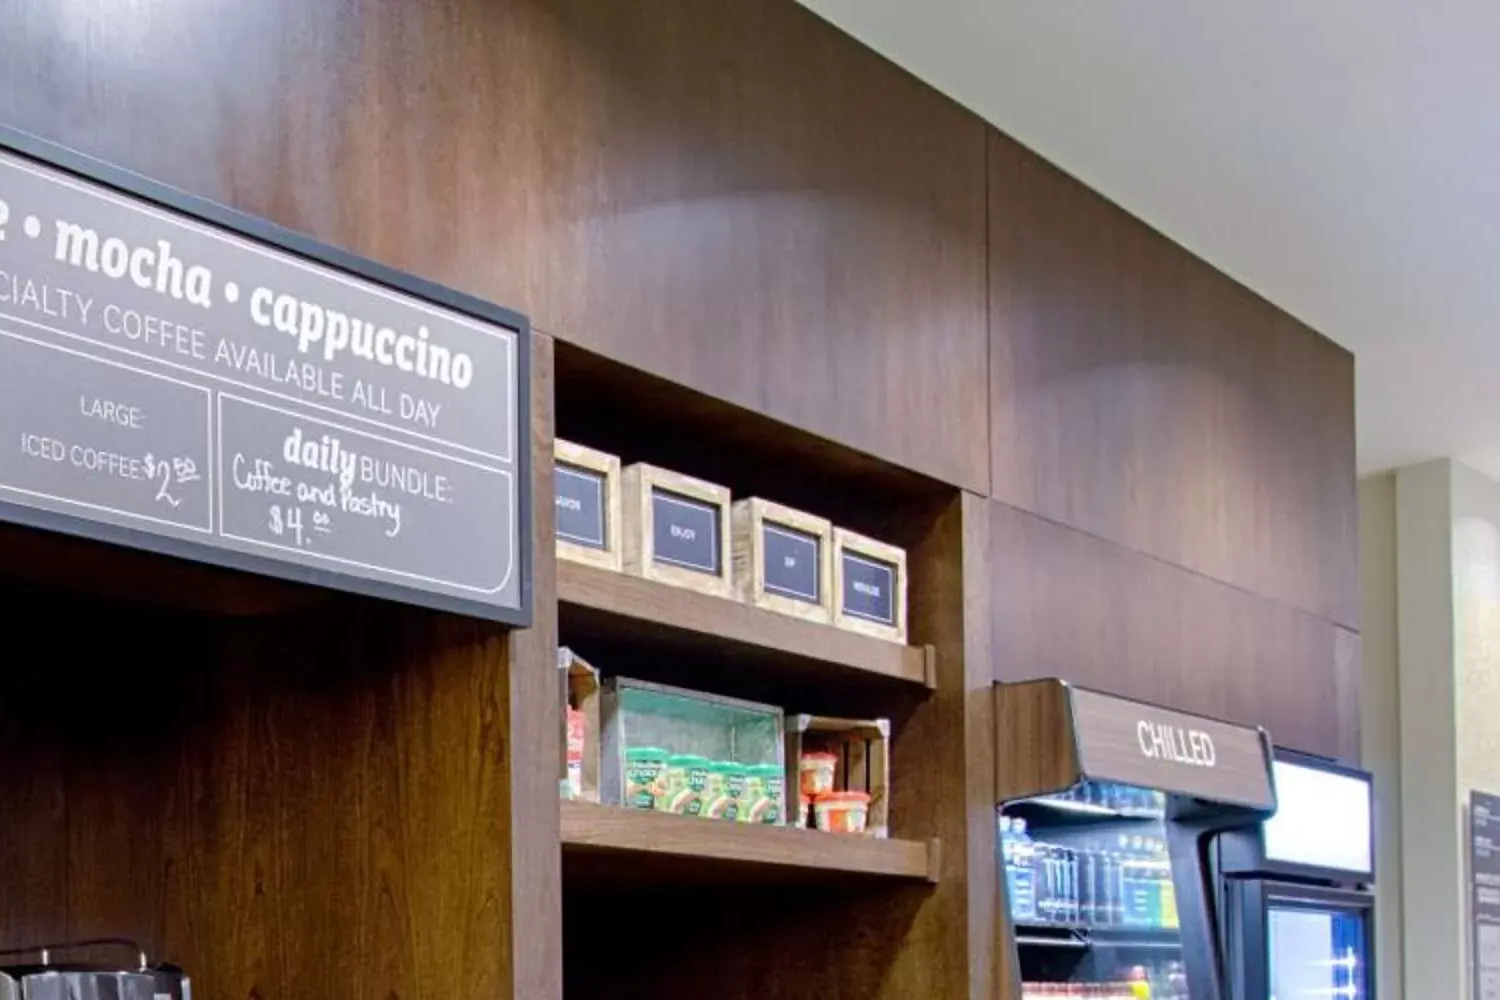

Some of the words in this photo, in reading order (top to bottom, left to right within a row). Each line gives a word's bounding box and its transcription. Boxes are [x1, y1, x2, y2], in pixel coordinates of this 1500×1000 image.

[54, 219, 212, 309] mocha
[250, 285, 474, 390] cappuccino
[102, 303, 206, 360] COFFEE
[214, 338, 345, 400] AVAILABLE
[350, 379, 394, 415] ALL
[399, 393, 442, 428] DAY
[79, 395, 146, 430] LARGE:
[20, 432, 65, 463] ICED
[283, 426, 356, 489] daily
[360, 456, 454, 504] BUNDLE:
[232, 452, 292, 496] Coffee
[296, 481, 337, 507] and
[1136, 719, 1217, 768] CHILLED
